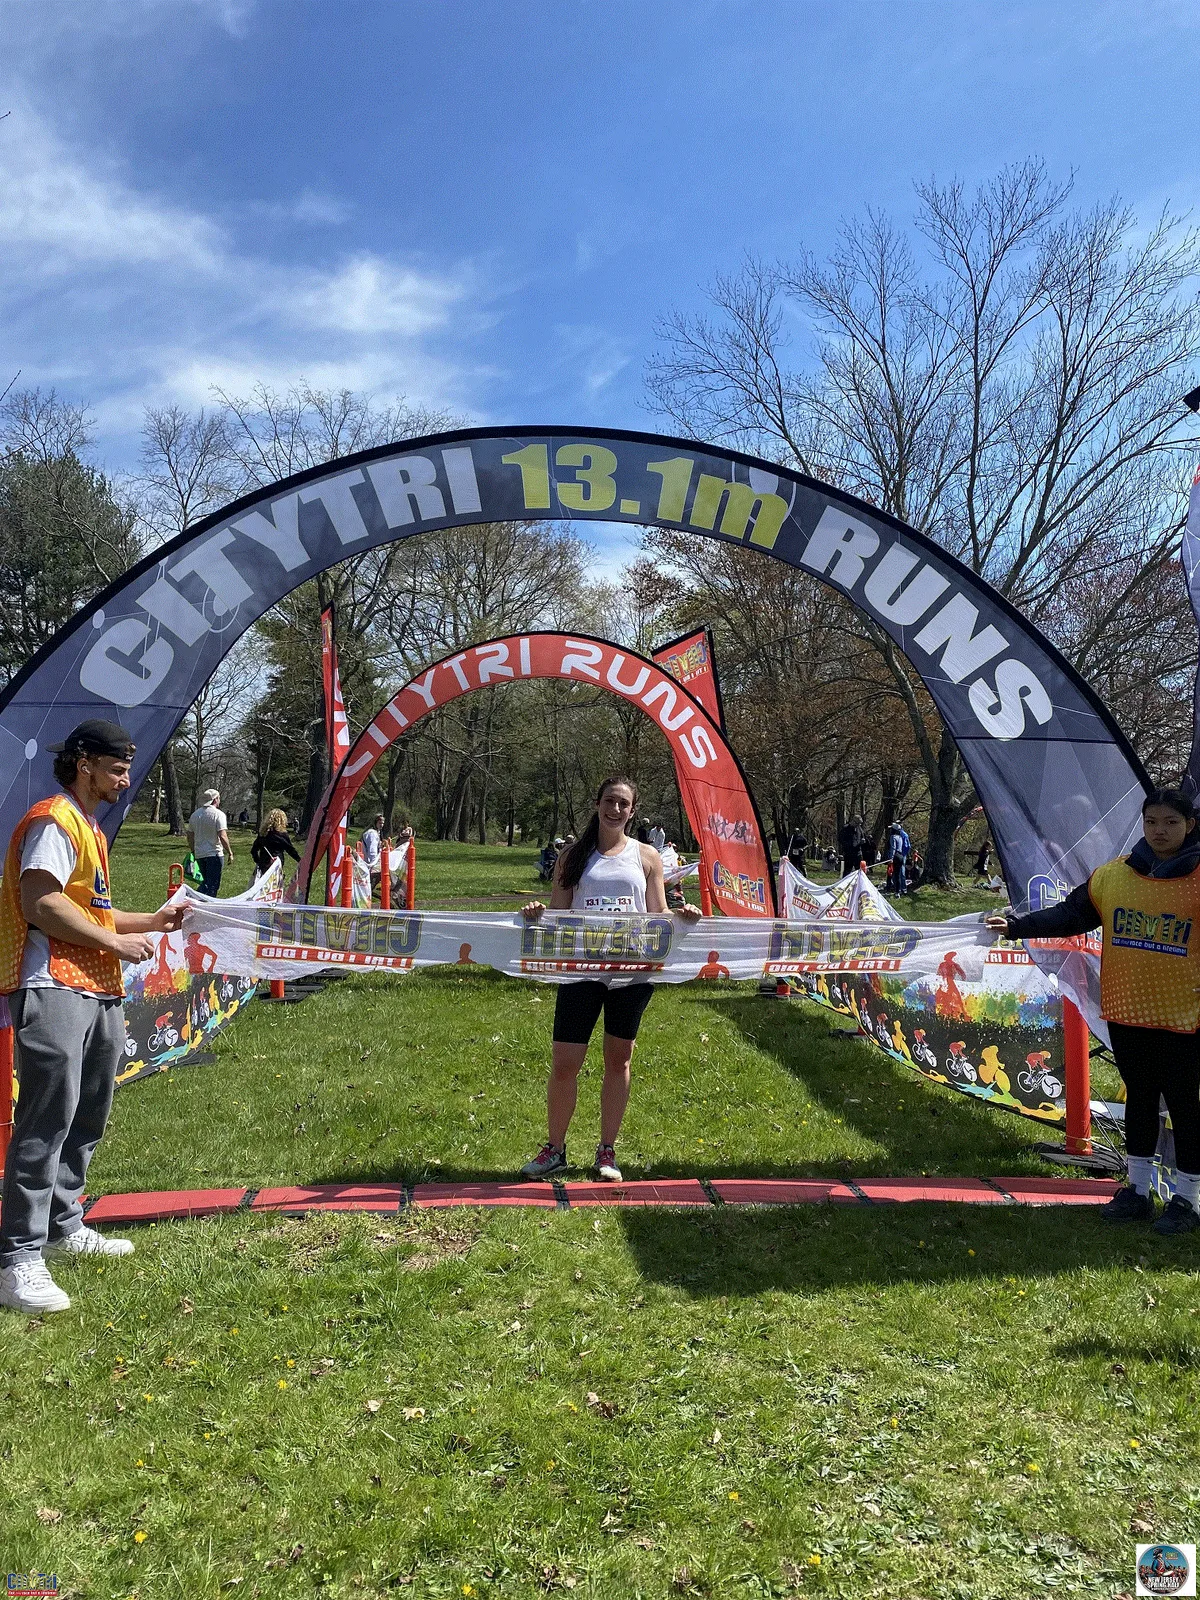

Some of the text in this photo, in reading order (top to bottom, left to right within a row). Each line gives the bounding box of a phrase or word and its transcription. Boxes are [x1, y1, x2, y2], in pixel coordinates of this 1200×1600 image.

[80, 443, 1053, 741] CITYTRI 13.1m RUNS
[561, 640, 717, 768] RUNS
[586, 898, 599, 906] 13.1
[713, 860, 766, 904] CityTri
[1113, 907, 1192, 944] CityTri
[1007, 954, 1013, 962] I
